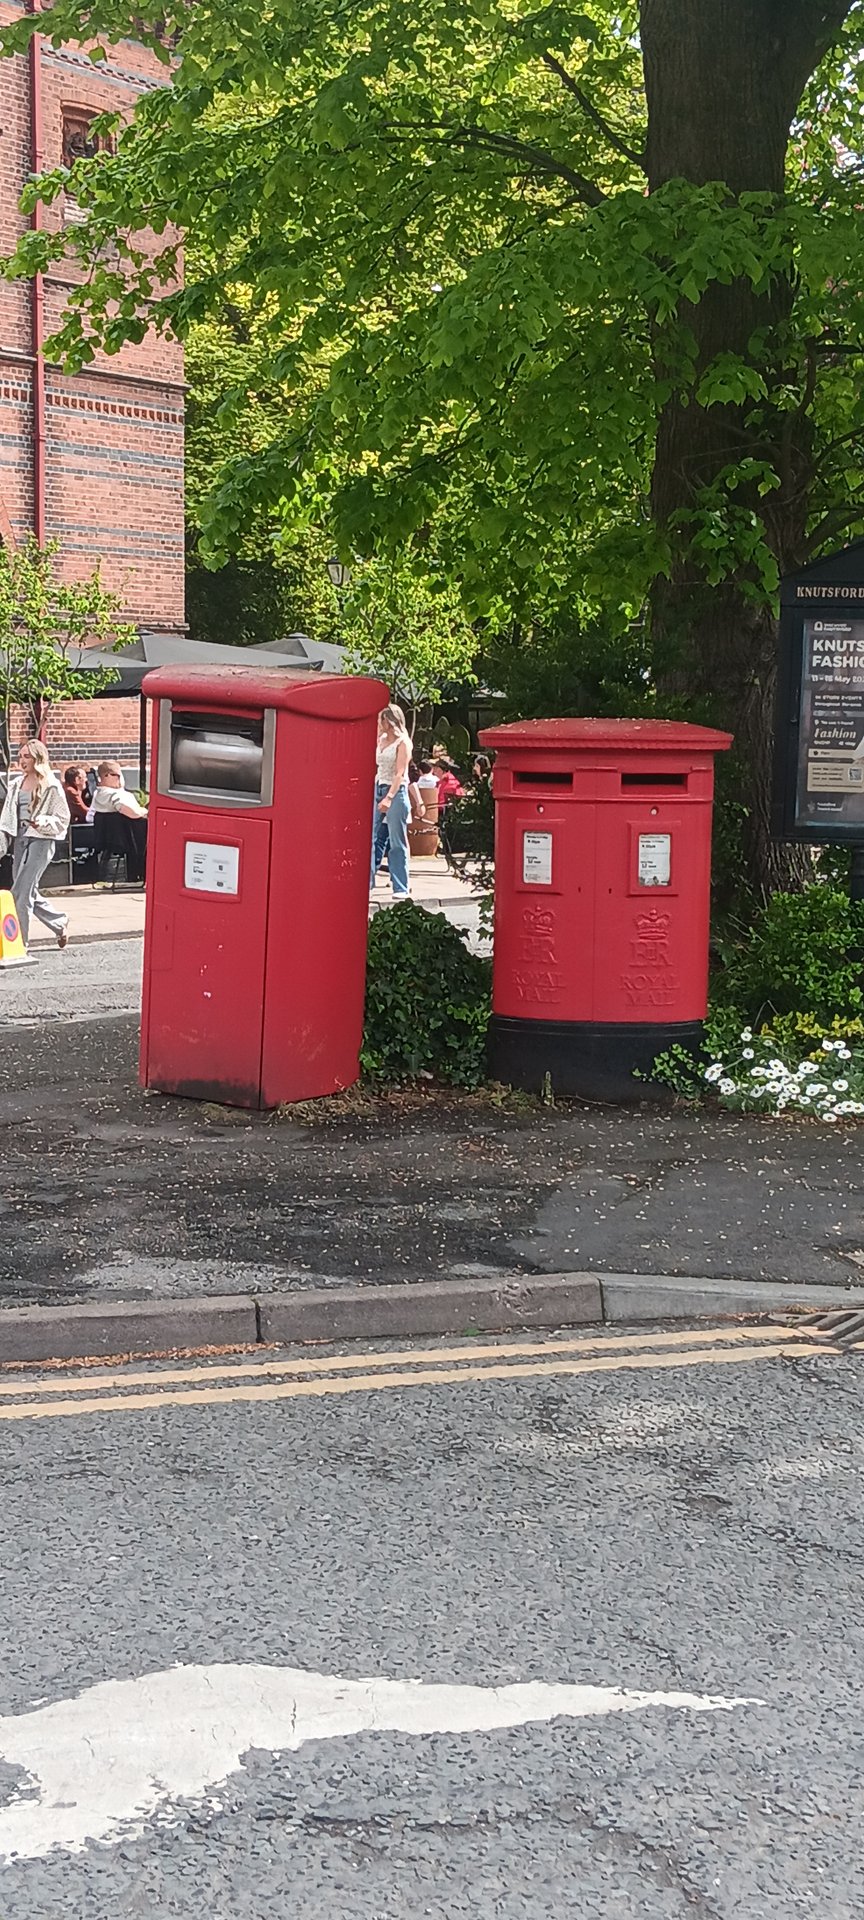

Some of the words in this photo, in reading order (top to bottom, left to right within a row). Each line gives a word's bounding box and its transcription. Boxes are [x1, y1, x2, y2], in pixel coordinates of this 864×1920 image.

[797, 586, 864, 598] KNUTSFORD
[813, 639, 864, 652] KNUTS
[834, 675, 851, 684] May
[814, 727, 857, 739] Fashion
[618, 974, 680, 990] ROYAL
[624, 989, 676, 1007] MAIL
